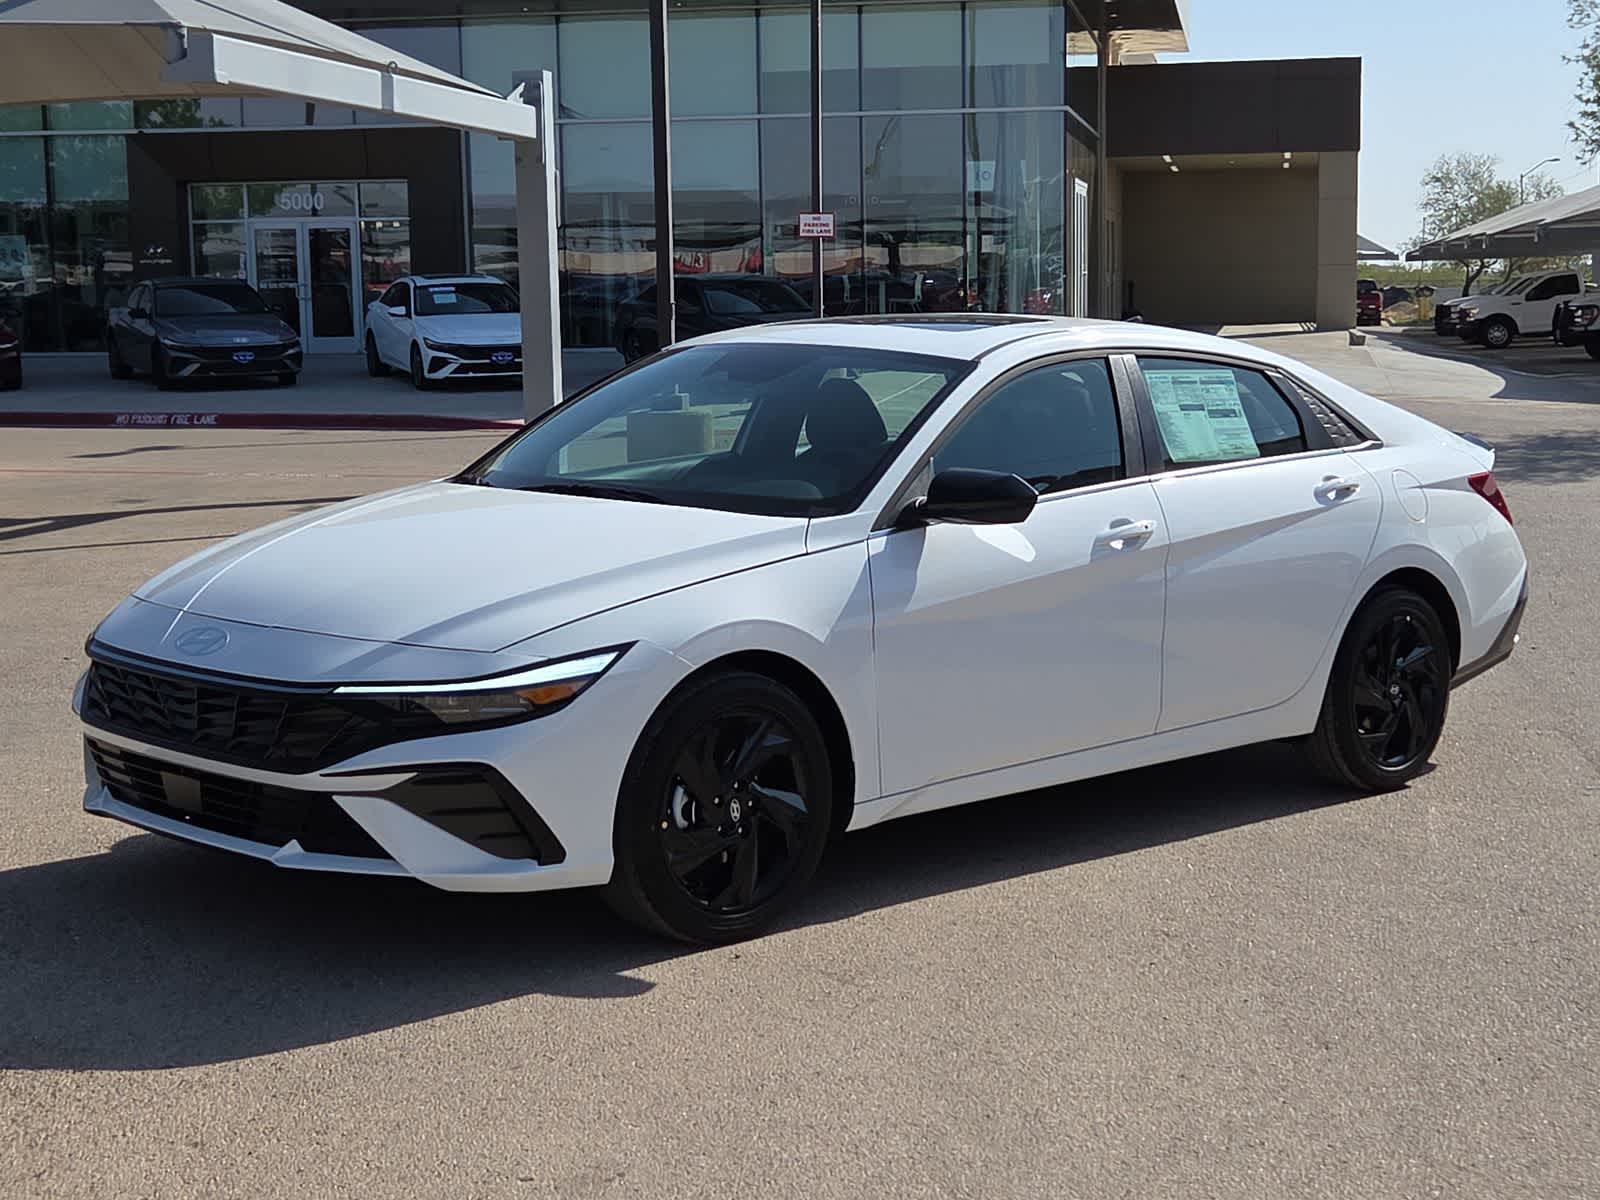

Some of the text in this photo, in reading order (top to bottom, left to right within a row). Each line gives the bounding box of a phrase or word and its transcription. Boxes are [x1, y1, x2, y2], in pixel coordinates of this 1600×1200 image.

[280, 191, 325, 210] 5000
[116, 414, 129, 425] NO
[193, 414, 219, 425] LANE
